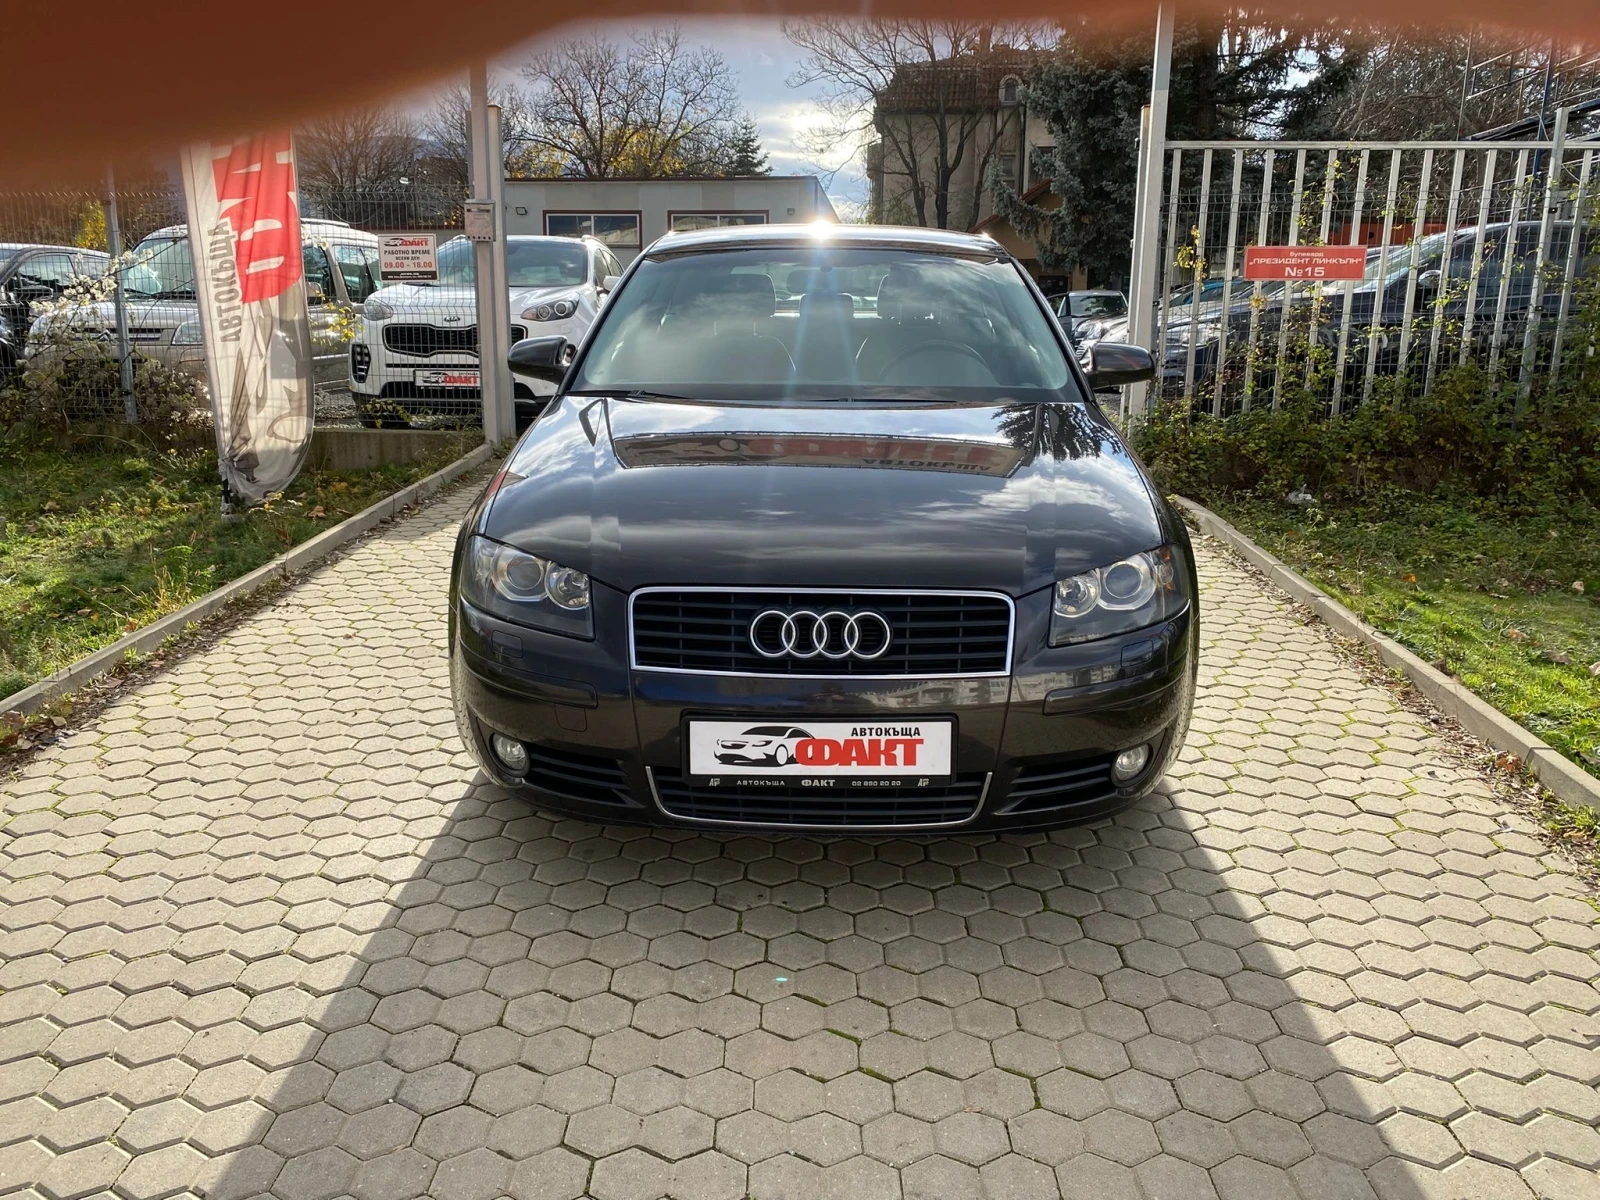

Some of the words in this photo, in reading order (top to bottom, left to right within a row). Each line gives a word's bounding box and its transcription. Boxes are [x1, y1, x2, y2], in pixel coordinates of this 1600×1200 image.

[1284, 266, 1326, 277] №15
[207, 221, 241, 343] АВТОКЪЩА
[851, 727, 921, 738] АВТОКЪЩА
[795, 738, 924, 766] ФАКТ
[801, 779, 835, 787] ФАКТ
